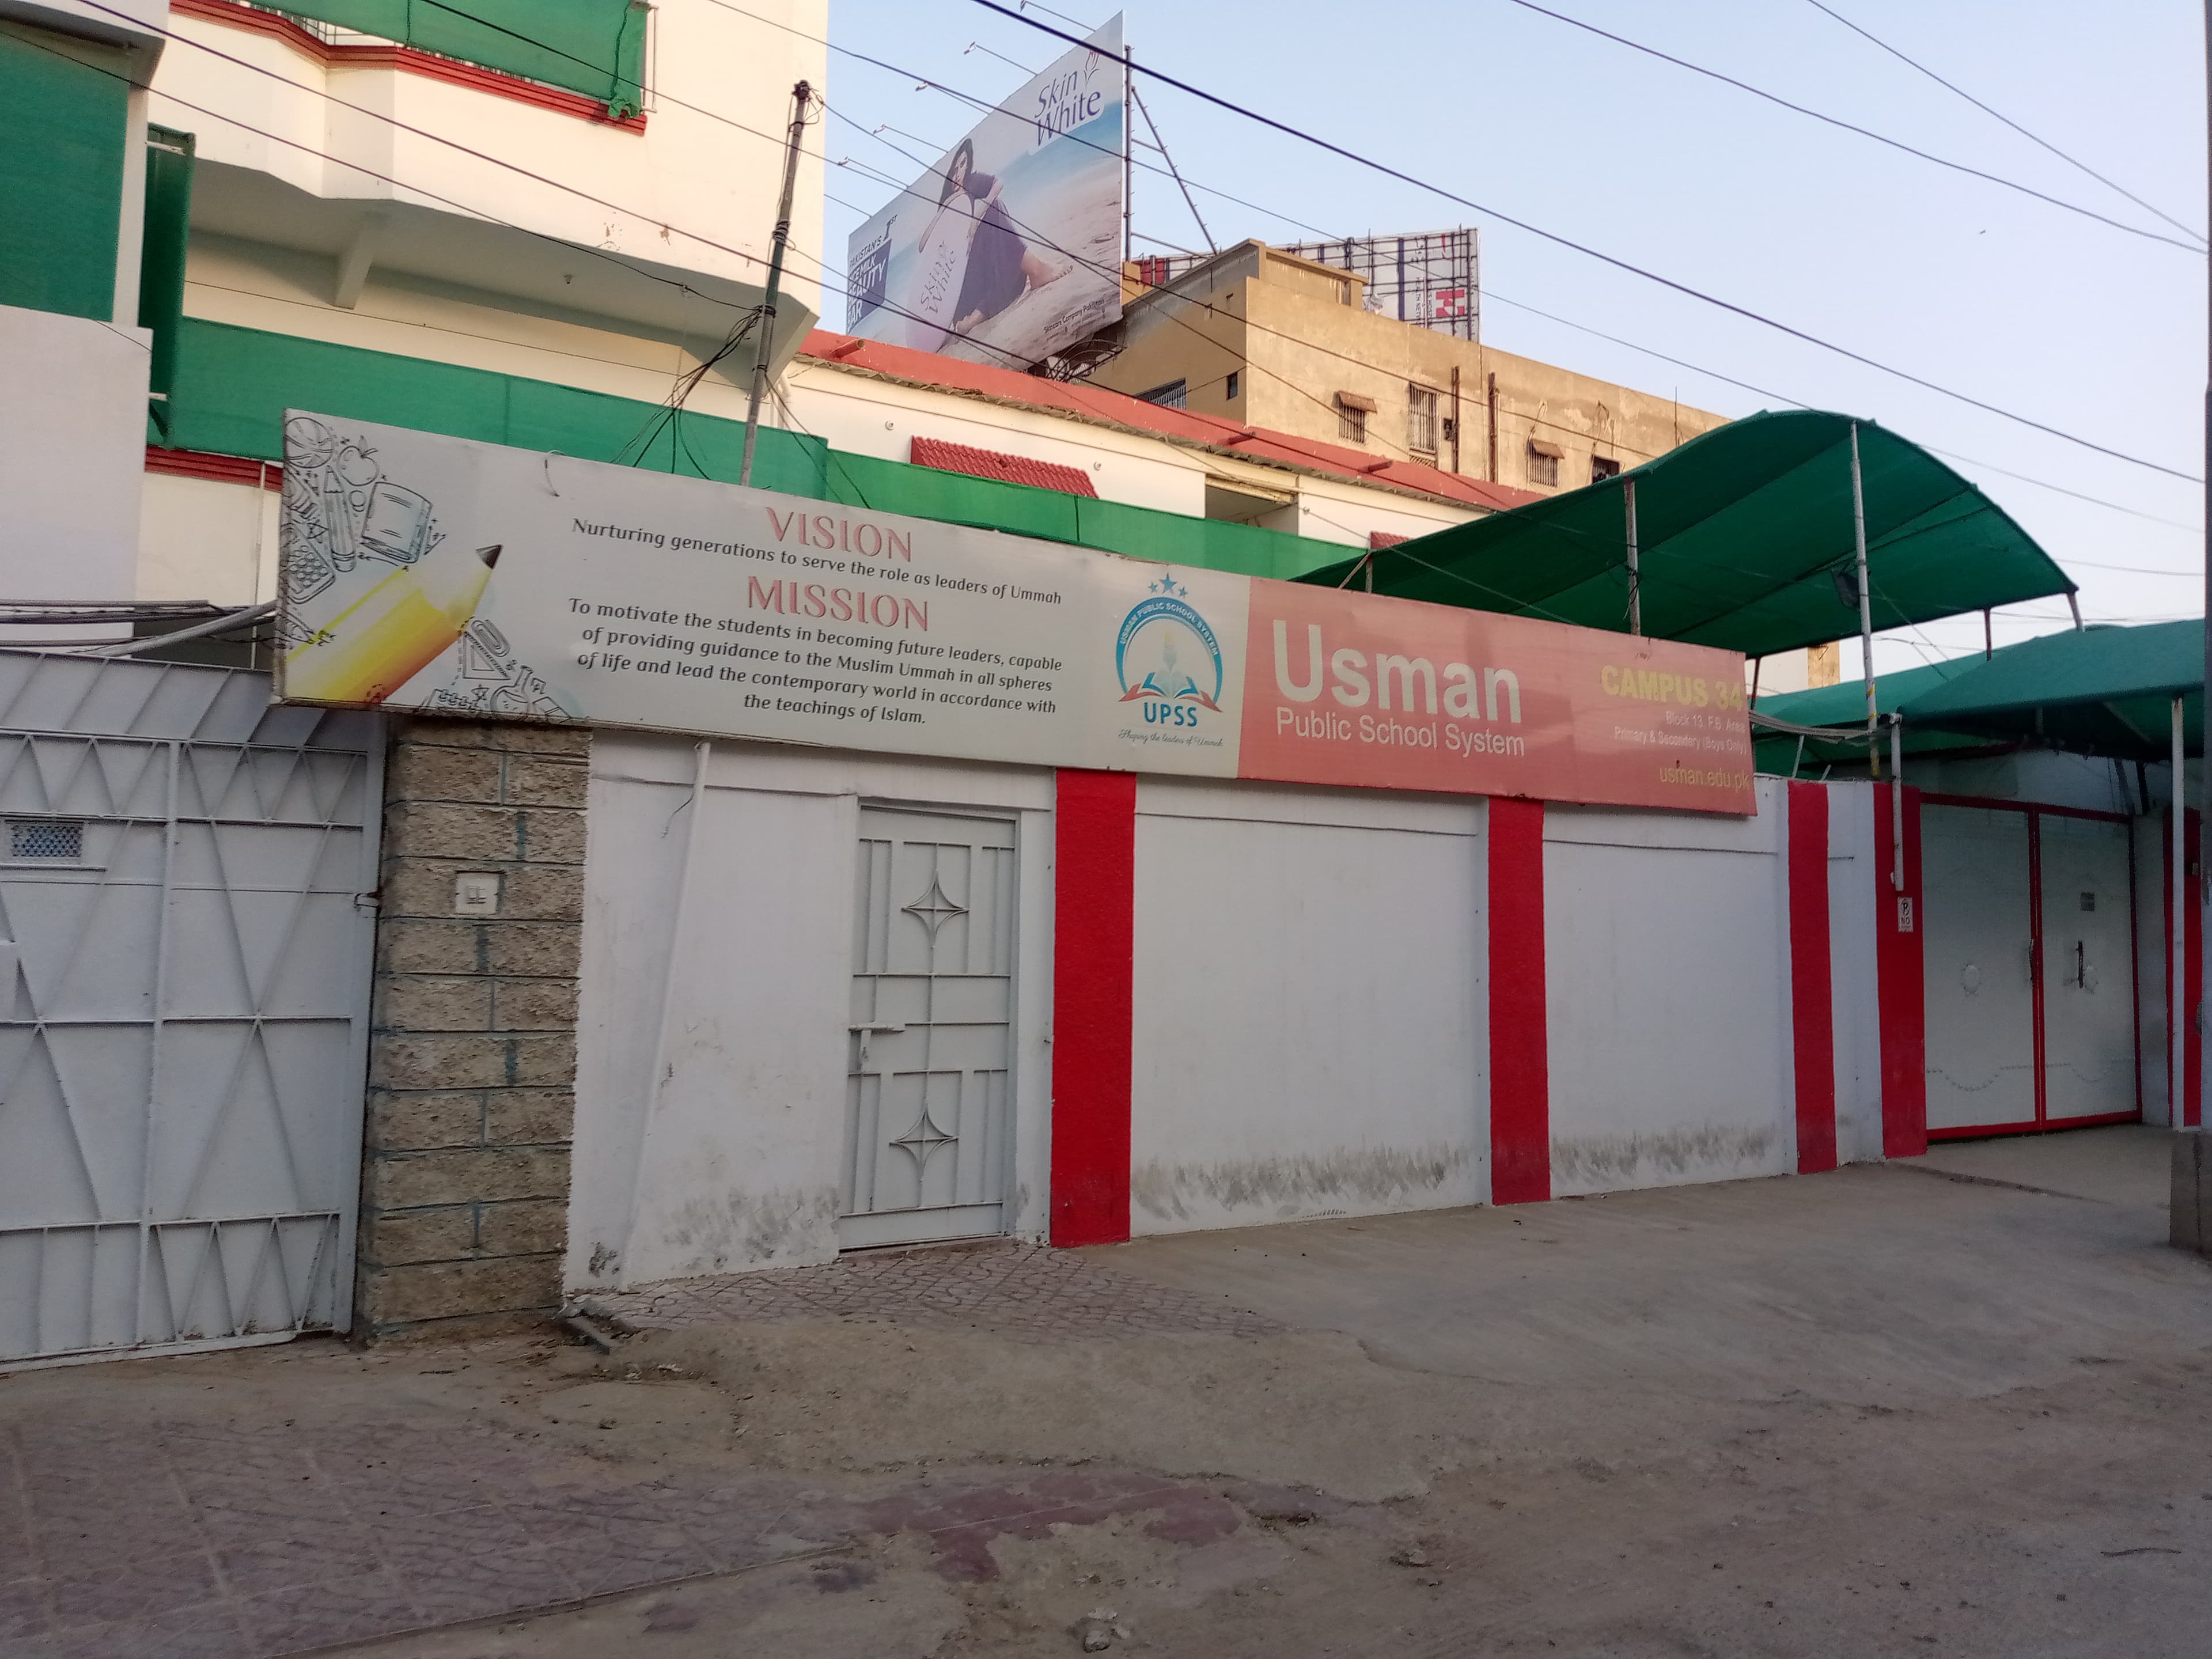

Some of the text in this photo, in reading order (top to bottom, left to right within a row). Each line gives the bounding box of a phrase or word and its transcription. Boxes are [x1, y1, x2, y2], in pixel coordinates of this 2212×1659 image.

[1035, 70, 1078, 118] Skin
[1037, 91, 1101, 146] White
[1062, 309, 1082, 323] Company
[1083, 299, 1105, 312] Pakistan
[572, 518, 1061, 604] Nurturing generations to serve the role as leaders of Ummah
[766, 507, 911, 562] VISION
[748, 575, 928, 632] MISSION
[1119, 602, 1219, 656] USMAN PUBLIC SCHOOL SYSTEM
[569, 598, 1062, 672] To motivate the students in becoming future leaders, capable
[582, 627, 1052, 692] of providing guidance to the Muslim Ummah in all spheres
[577, 652, 1056, 714] of life and lead the contemporary world in accordance with
[1272, 619, 1522, 724] Usman
[1601, 665, 1744, 712] CAMPUS 34
[743, 694, 926, 724] the teachings of Islam.
[1144, 702, 1198, 727] UPSS
[1277, 706, 1525, 758] Public School System
[1118, 729, 1149, 744] Shaping
[1150, 732, 1161, 741] the
[1185, 736, 1195, 747] of
[1615, 726, 1647, 745] Primary
[1649, 730, 1656, 743] &
[1658, 730, 1701, 750] Secondary
[1660, 767, 1749, 793] usman.edu.pk
